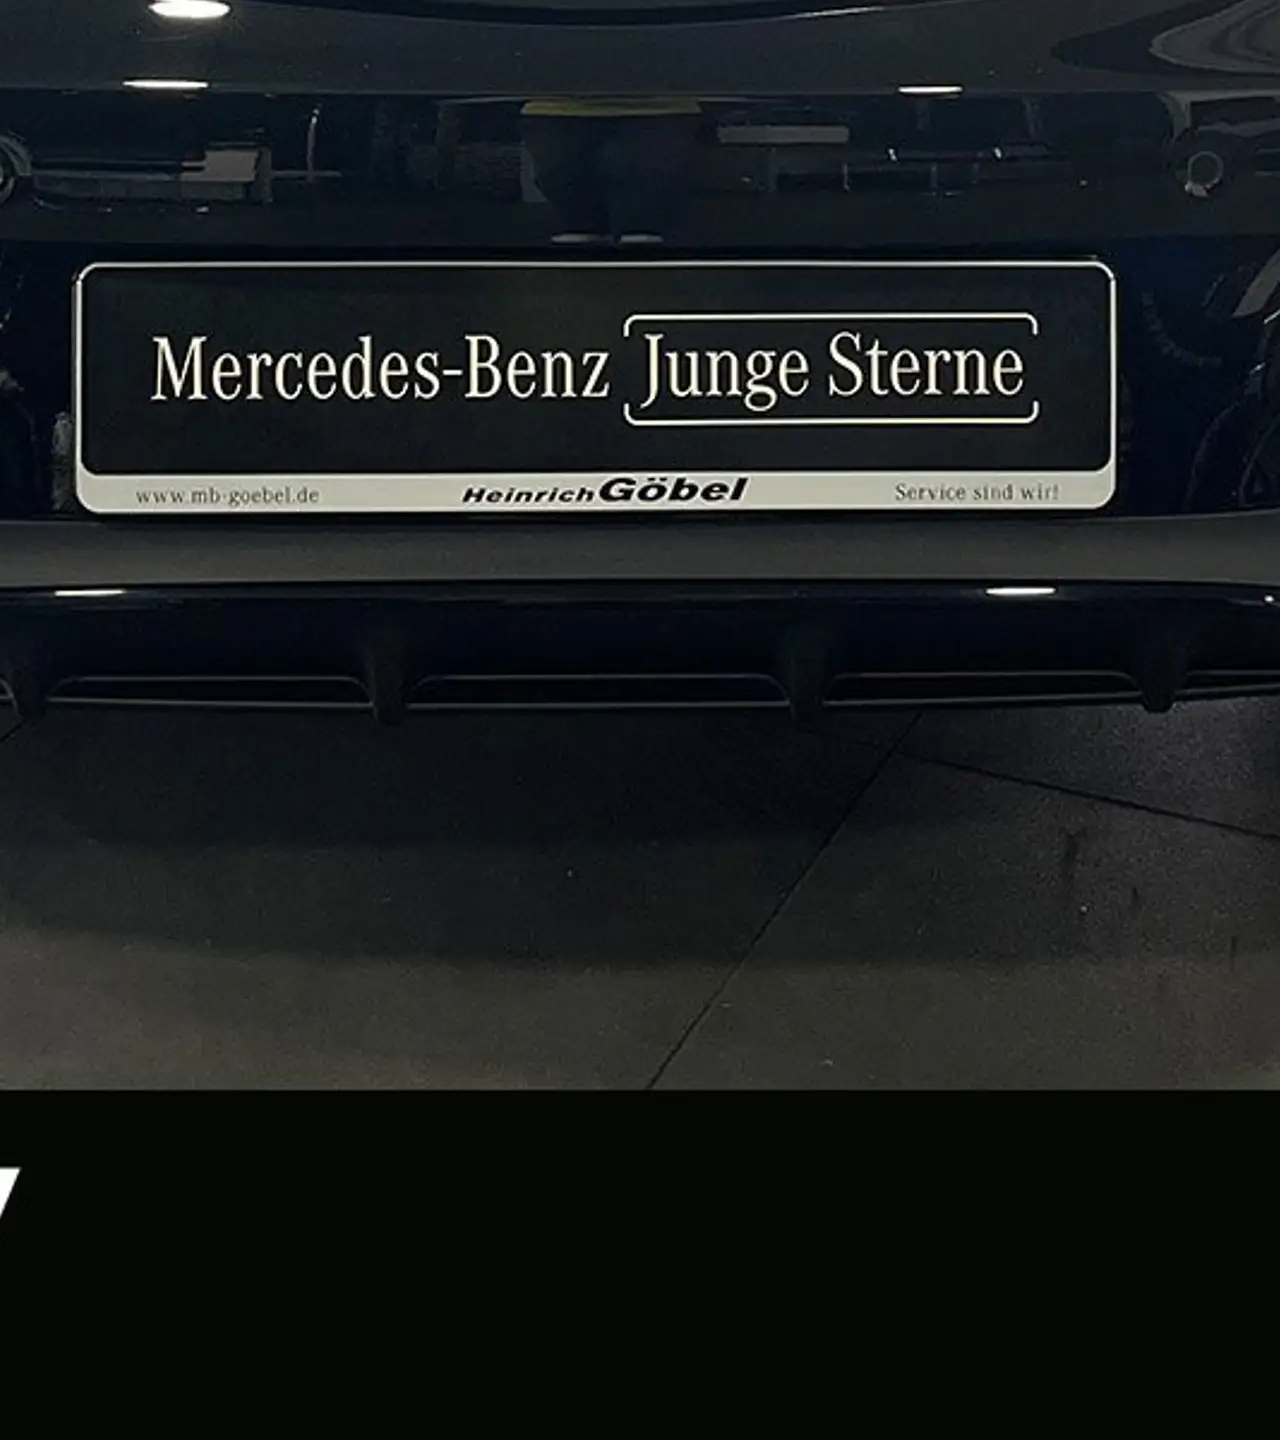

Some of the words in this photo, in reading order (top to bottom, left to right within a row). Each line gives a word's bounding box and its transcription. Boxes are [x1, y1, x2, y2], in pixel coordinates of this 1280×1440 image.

[151, 334, 610, 400] Mercedes-Benz
[640, 334, 810, 412] Junge
[828, 331, 1024, 396] Sterne
[461, 486, 595, 504] Heinrich
[598, 477, 749, 503] Göbel
[894, 483, 966, 501] Service
[972, 483, 1014, 501] sind
[1020, 483, 1060, 501] wir!
